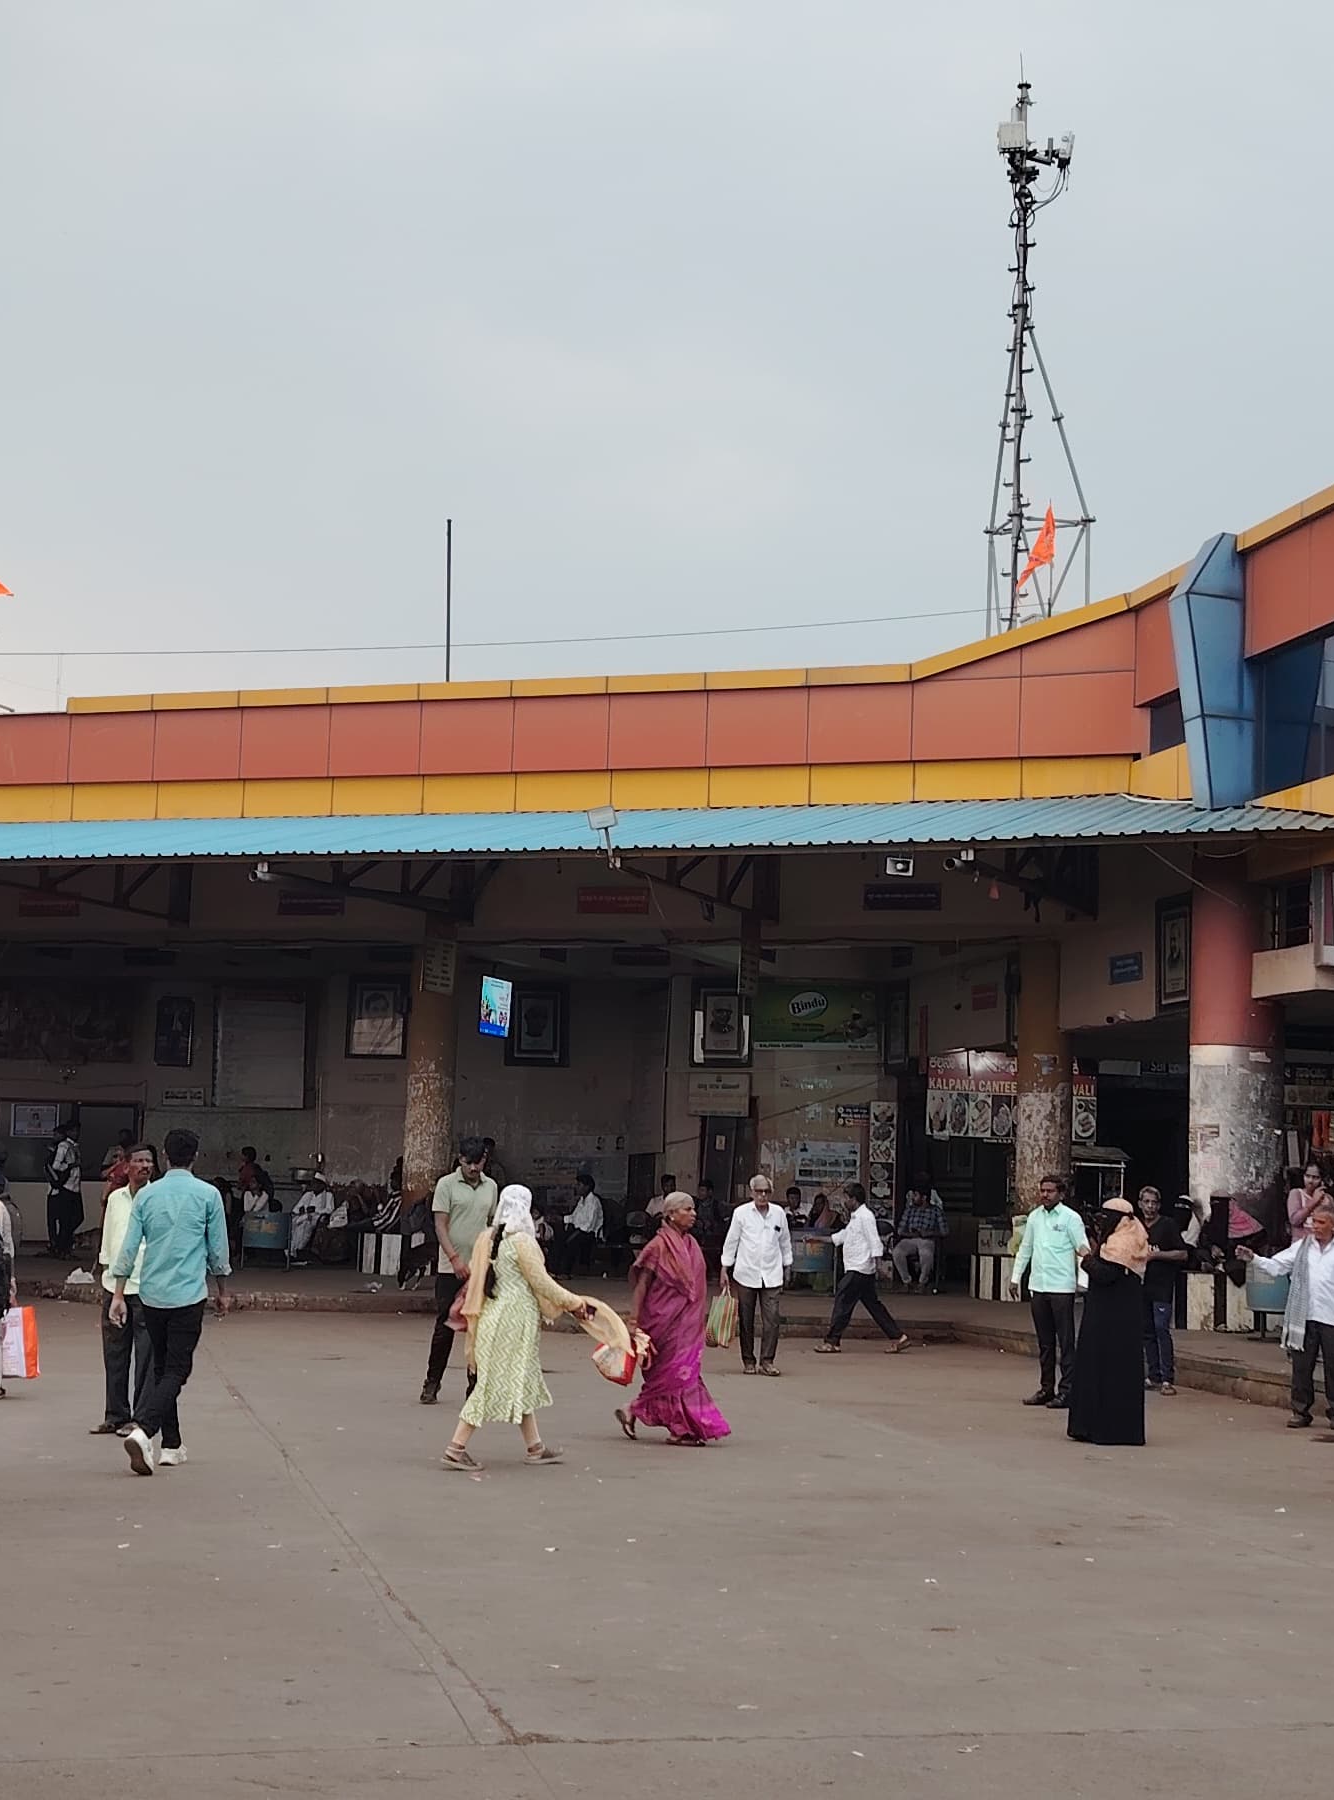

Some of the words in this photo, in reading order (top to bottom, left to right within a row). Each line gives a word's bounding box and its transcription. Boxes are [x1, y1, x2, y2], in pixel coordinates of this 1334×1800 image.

[791, 996, 826, 1016] Bindu
[929, 1077, 976, 1092] KALPANA
[978, 1079, 1018, 1094] CANTEE
